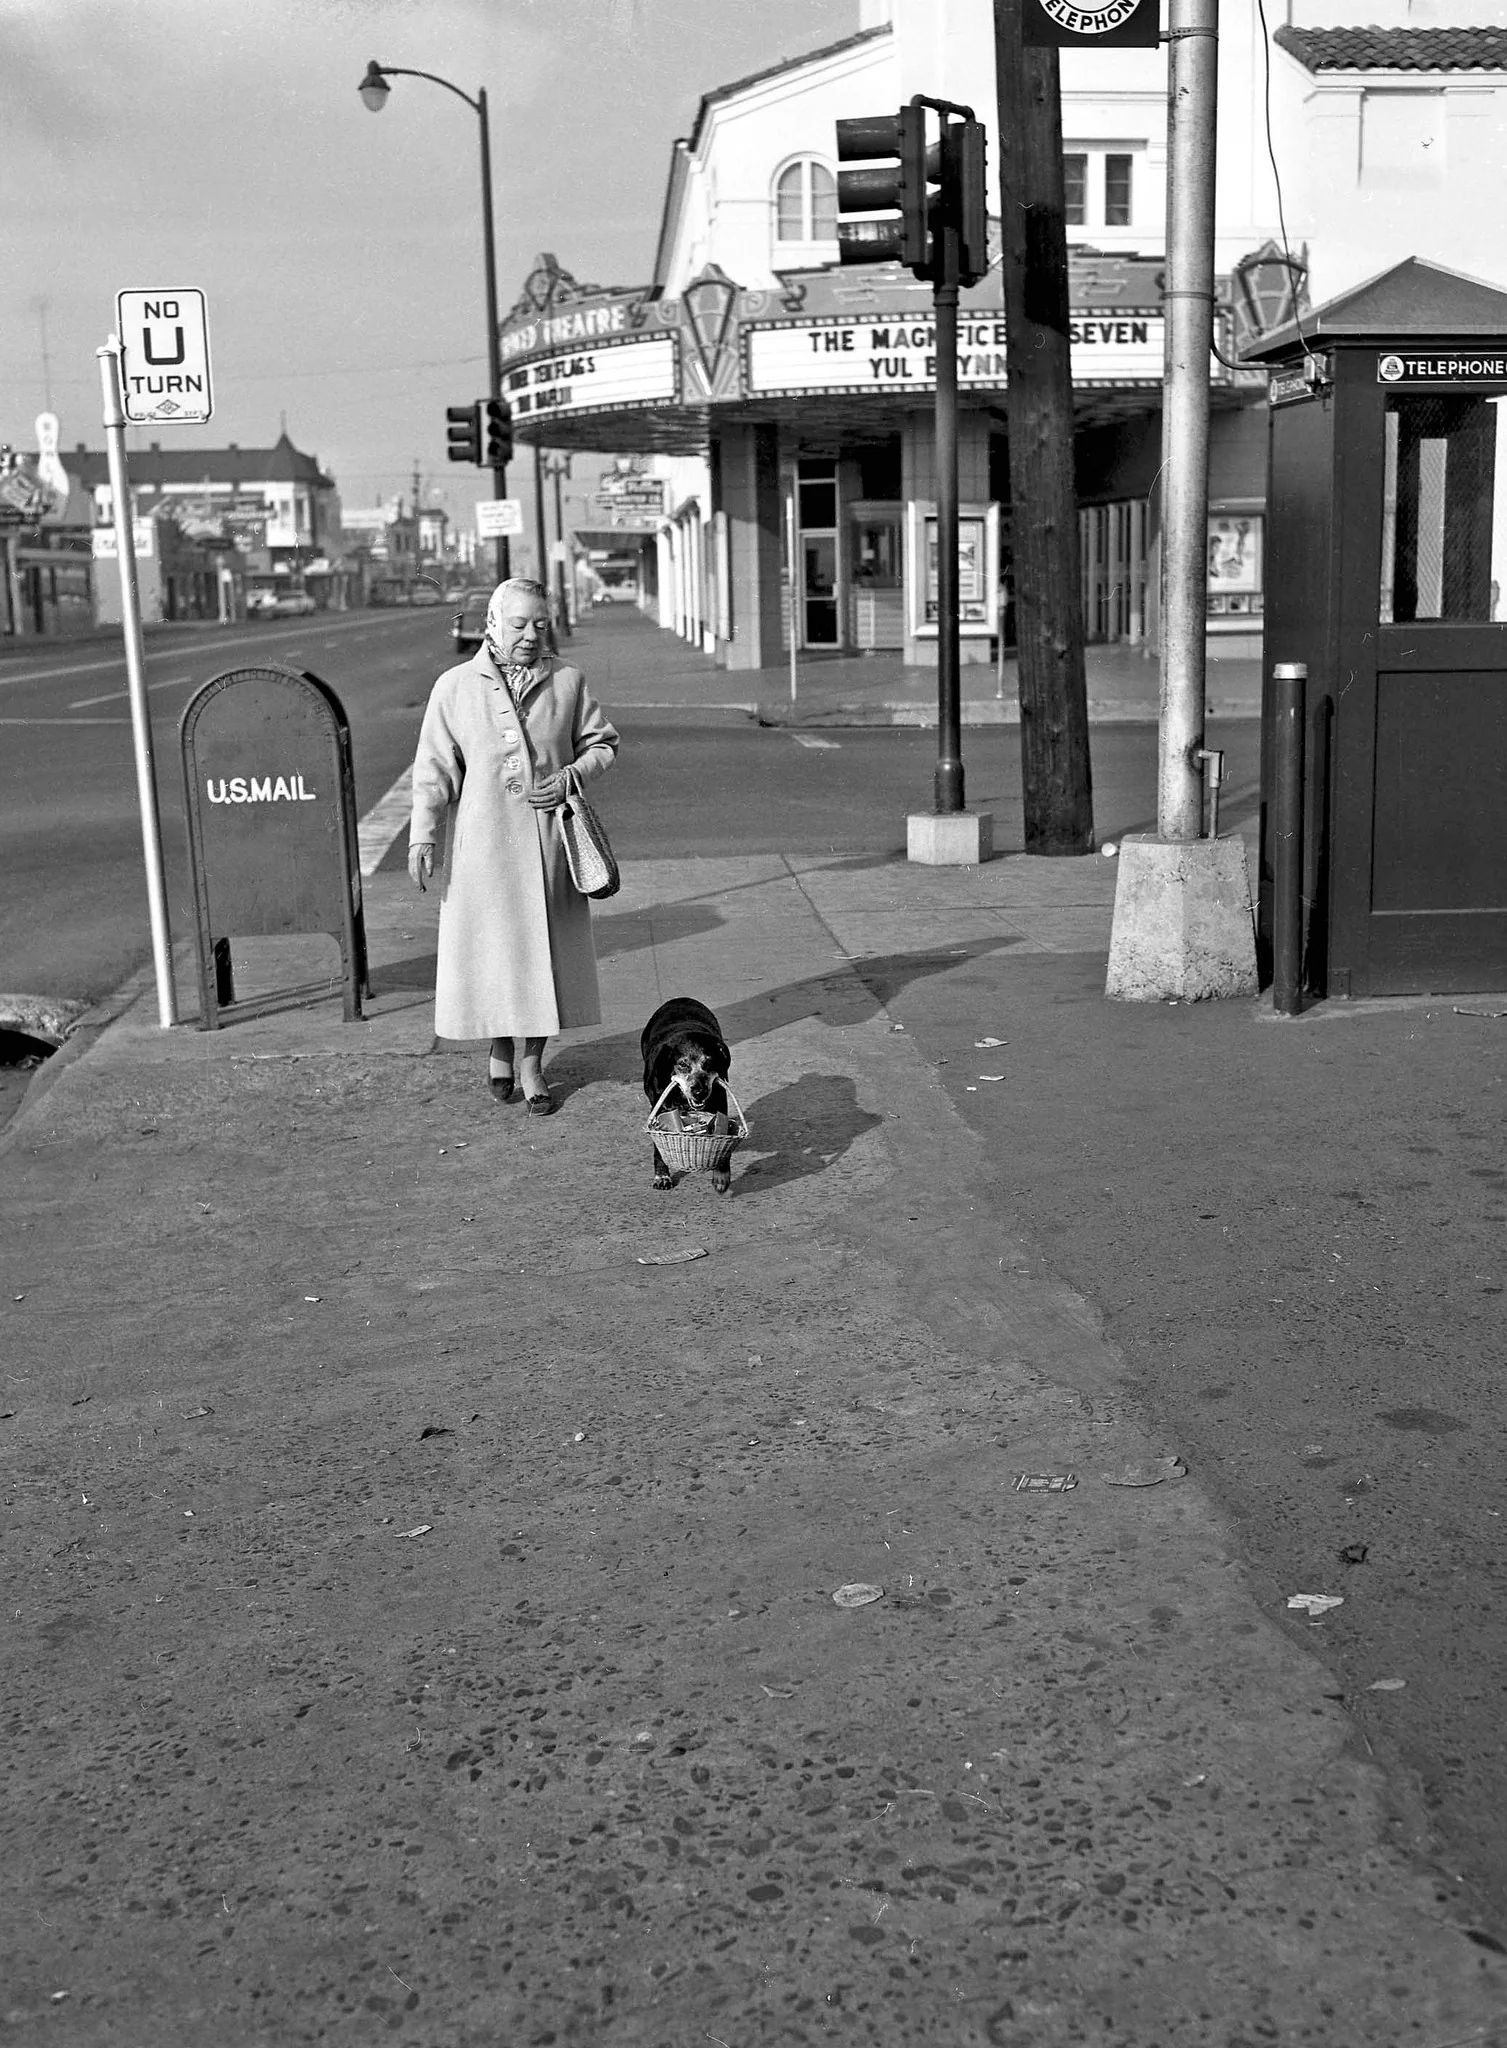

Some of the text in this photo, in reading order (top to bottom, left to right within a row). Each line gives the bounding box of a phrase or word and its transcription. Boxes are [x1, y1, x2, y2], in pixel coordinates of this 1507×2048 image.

[1044, 0, 1135, 30] ELEPHON
[144, 301, 179, 319] NO
[542, 304, 625, 345] THEATRE
[808, 322, 1148, 353] THE MAGNFICE SEVEN
[143, 326, 185, 365] U
[869, 353, 1007, 378] YUL BYNN
[1405, 360, 1504, 376] TELEPHONE
[130, 375, 202, 394] TURN
